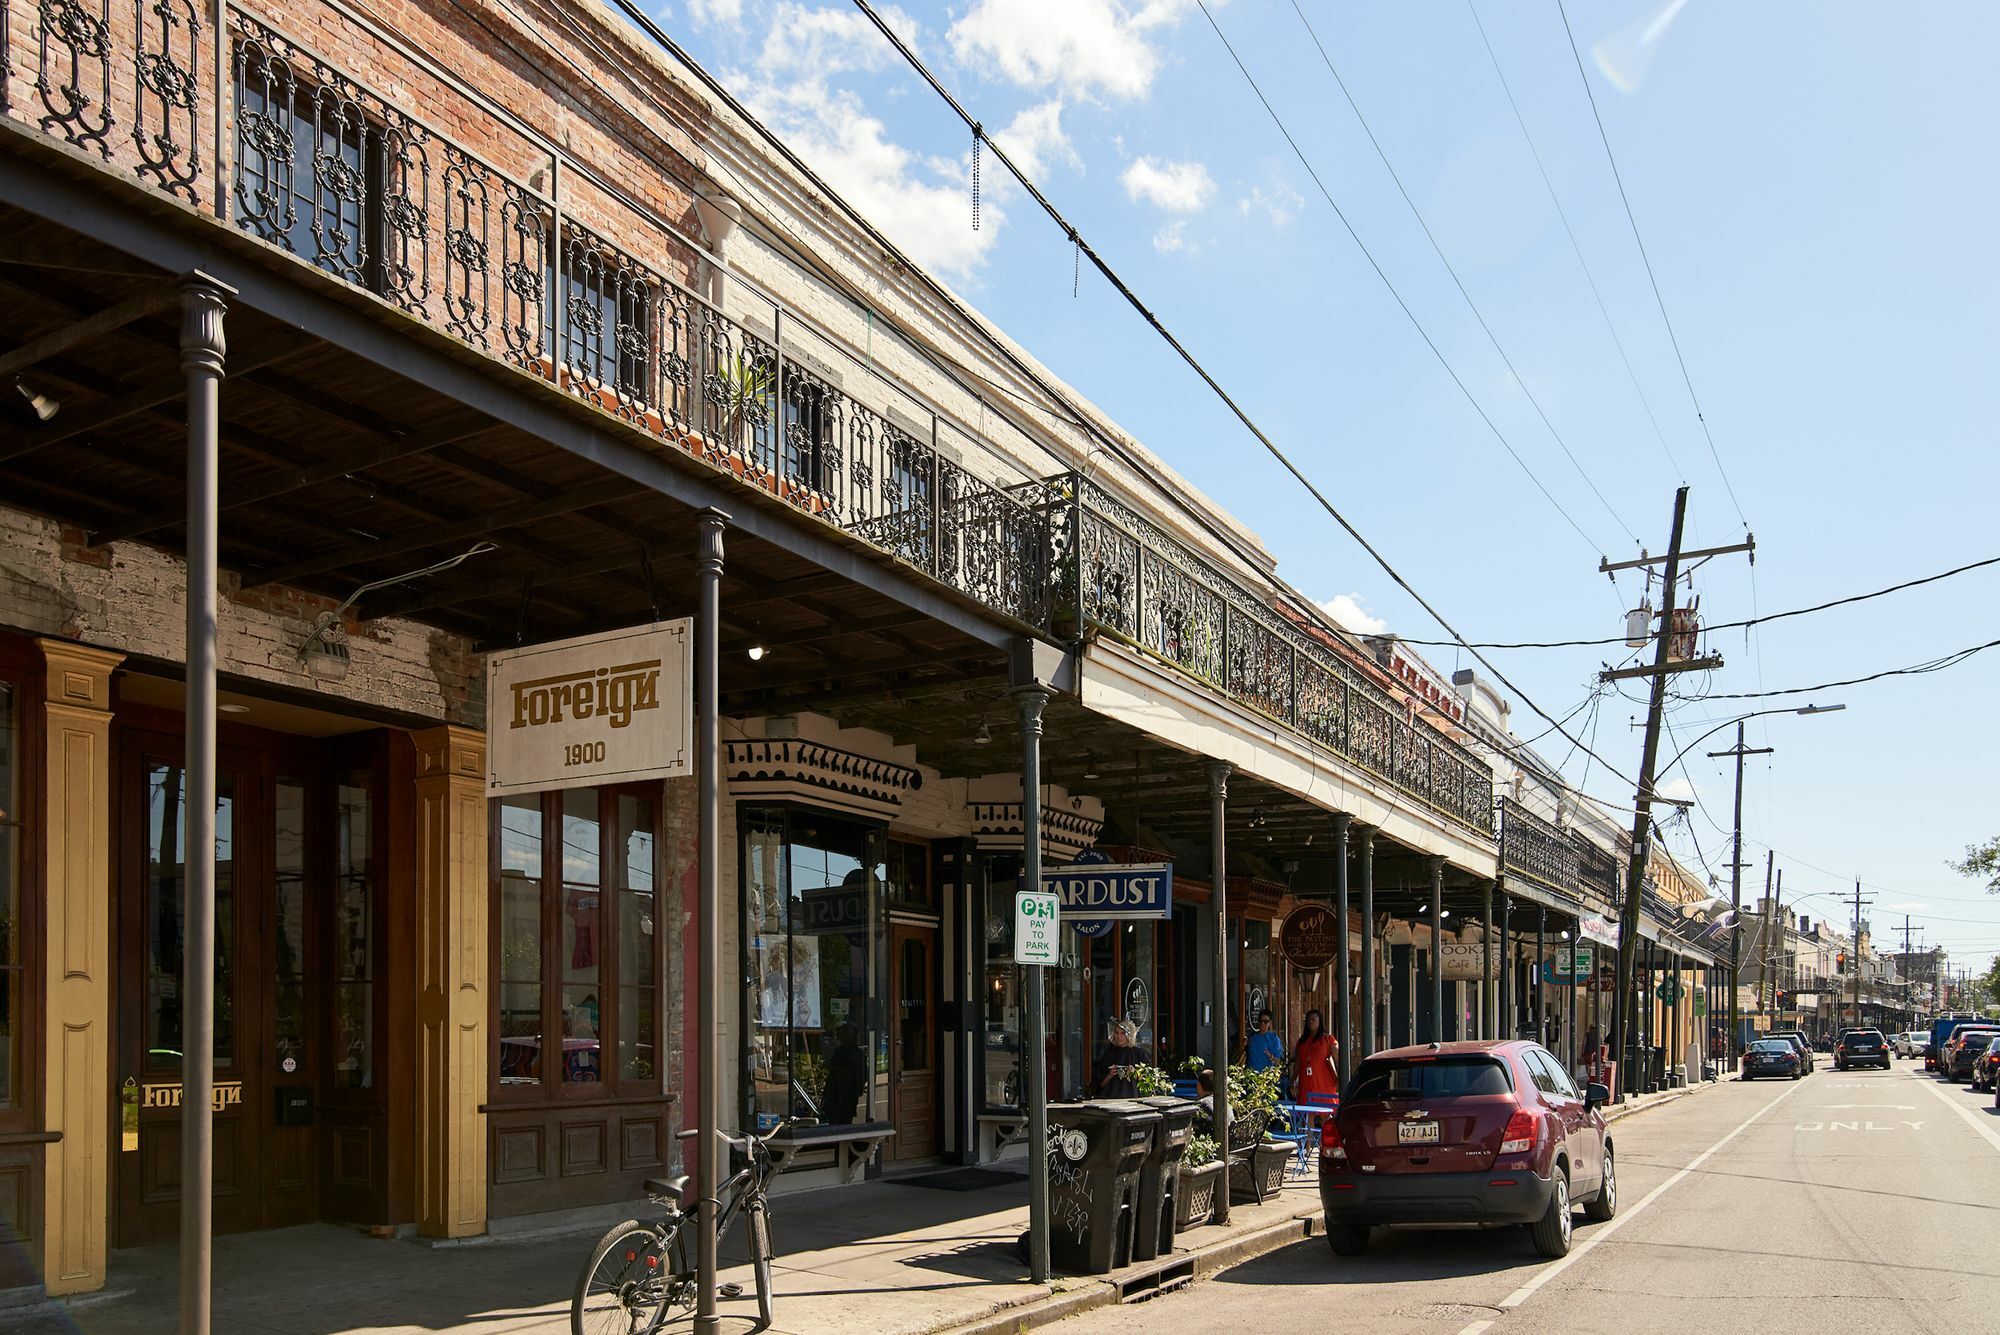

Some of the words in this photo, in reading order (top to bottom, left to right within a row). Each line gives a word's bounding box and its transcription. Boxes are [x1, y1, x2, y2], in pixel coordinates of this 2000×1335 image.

[510, 659, 662, 729] Foreign
[564, 741, 606, 767] 1900
[1042, 877, 1160, 906] TARDUST
[1030, 920, 1046, 928] PAY
[1075, 922, 1101, 934] SALON
[1032, 931, 1044, 939] TO
[1026, 941, 1050, 950] PARK
[142, 1081, 243, 1112] Forgn
[1794, 1120, 1927, 1131] ONLY
[1400, 1127, 1416, 1138] 427
[1422, 1126, 1438, 1137] AJI
